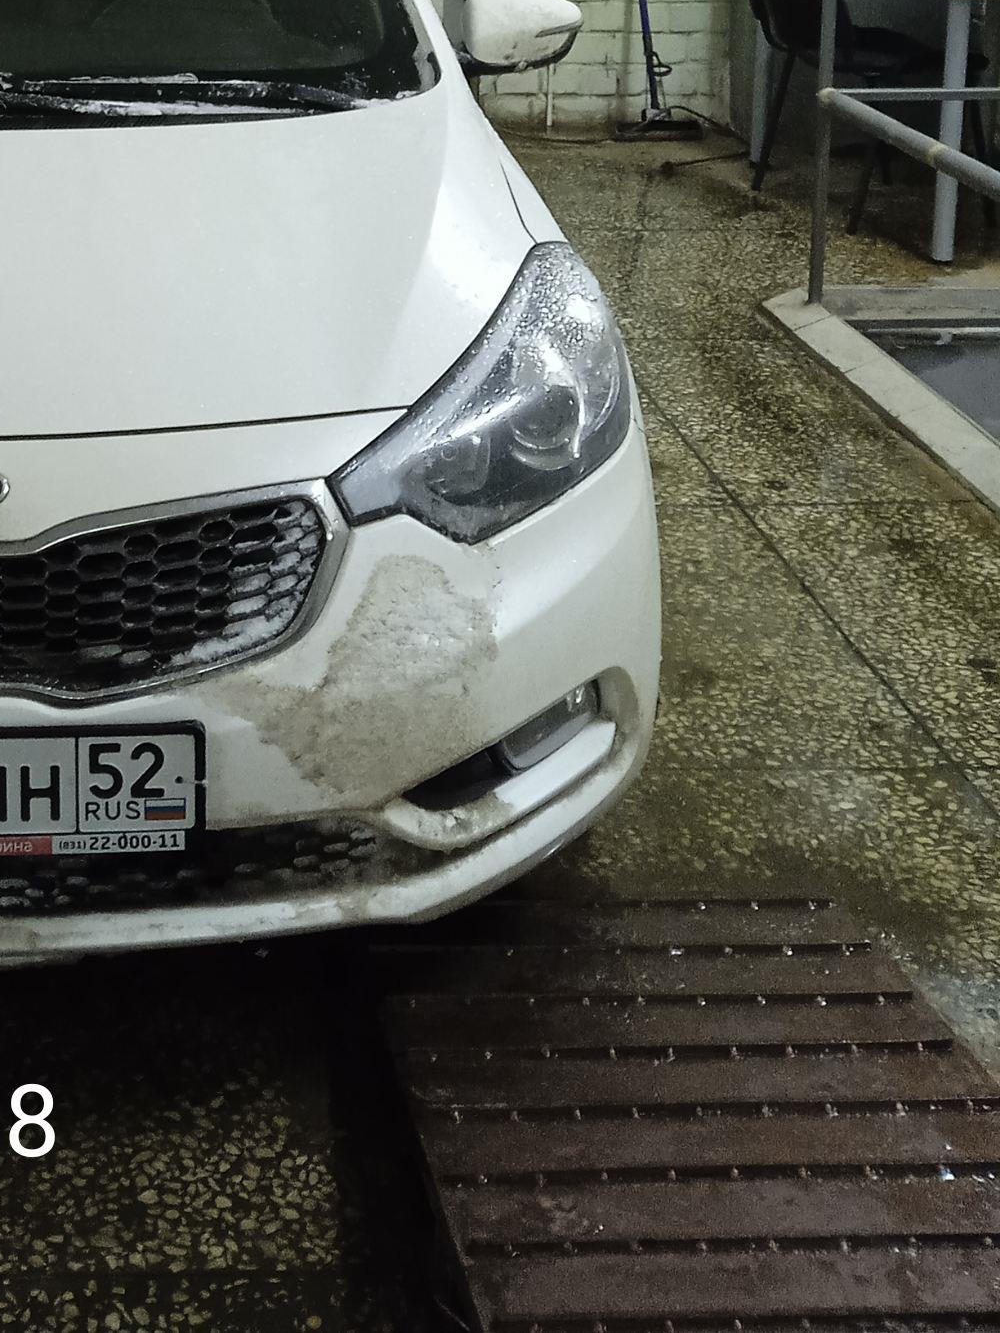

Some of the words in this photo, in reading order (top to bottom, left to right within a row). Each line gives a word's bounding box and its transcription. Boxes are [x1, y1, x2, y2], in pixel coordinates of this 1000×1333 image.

[88, 742, 165, 799] 52
[85, 800, 141, 821] RUS
[58, 840, 87, 850] (831)
[89, 833, 180, 850] 22-000-11
